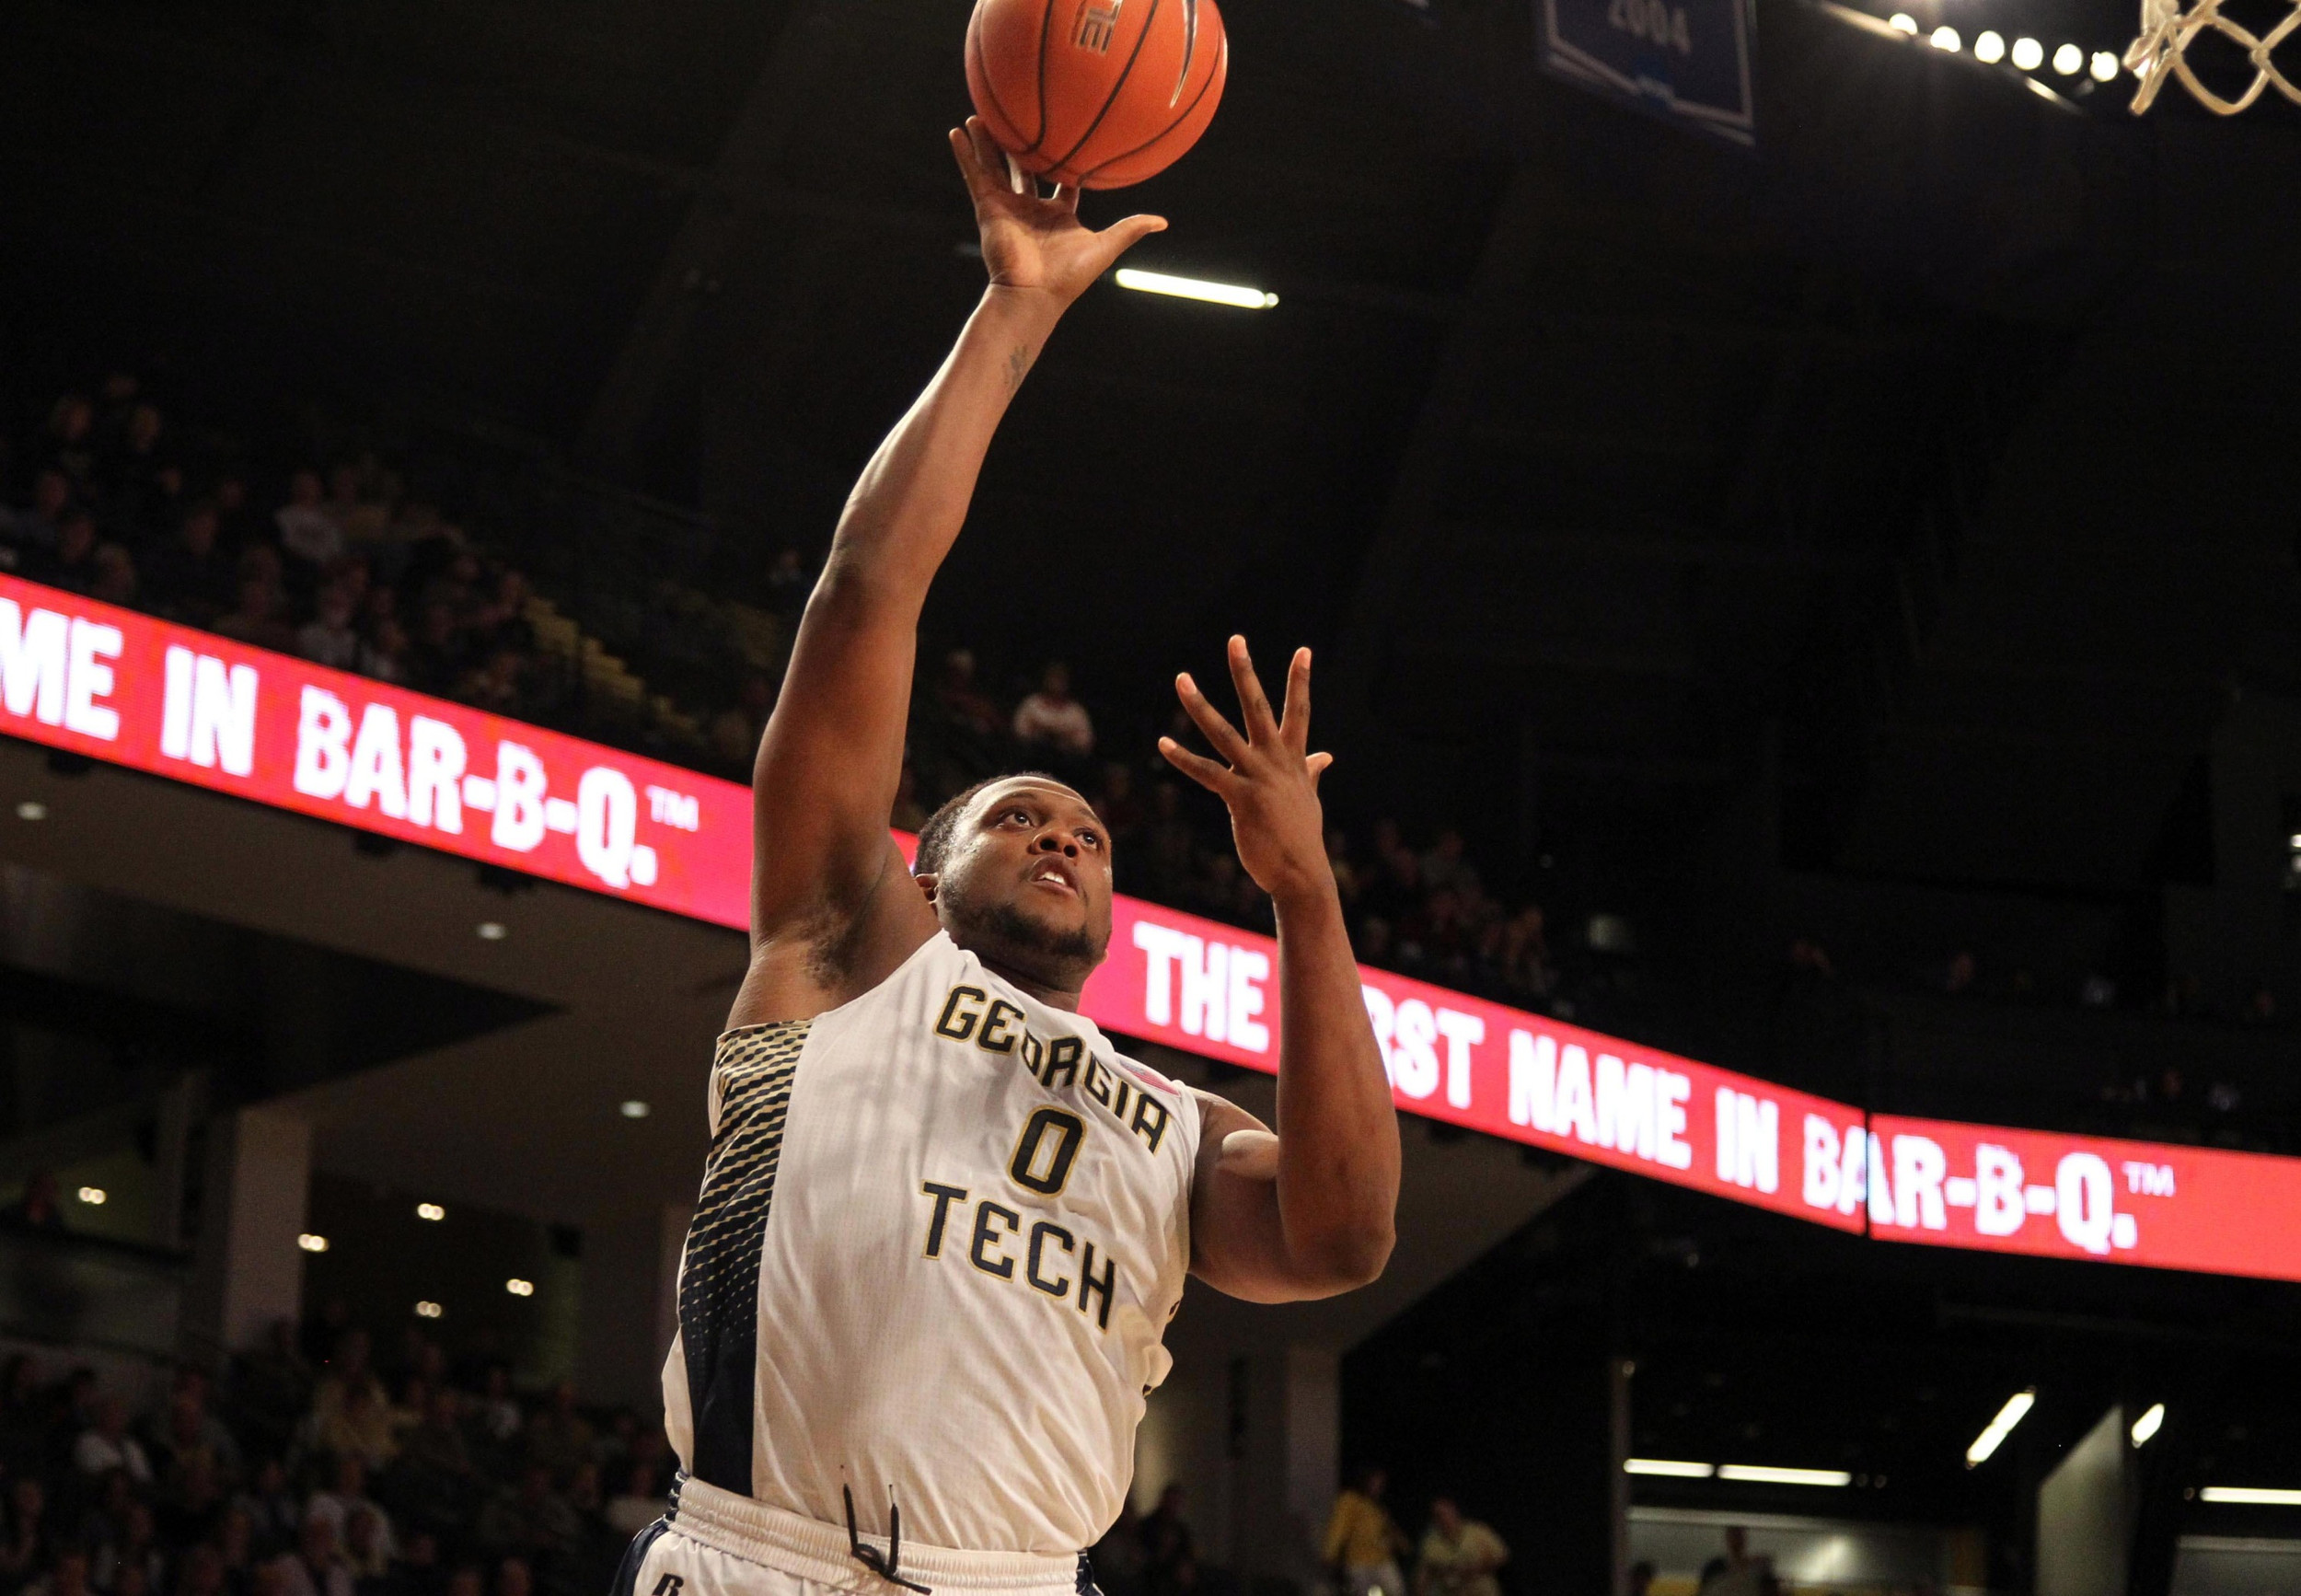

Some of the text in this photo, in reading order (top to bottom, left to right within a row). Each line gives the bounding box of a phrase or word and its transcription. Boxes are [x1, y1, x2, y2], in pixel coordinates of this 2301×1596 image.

[160, 644, 259, 779] IN
[932, 985, 1172, 1156] GEORGIA
[1132, 920, 1270, 1054] THE
[1507, 1028, 1693, 1171] NAME
[1715, 1086, 1780, 1196] IN
[919, 1179, 1116, 1334] TECH
